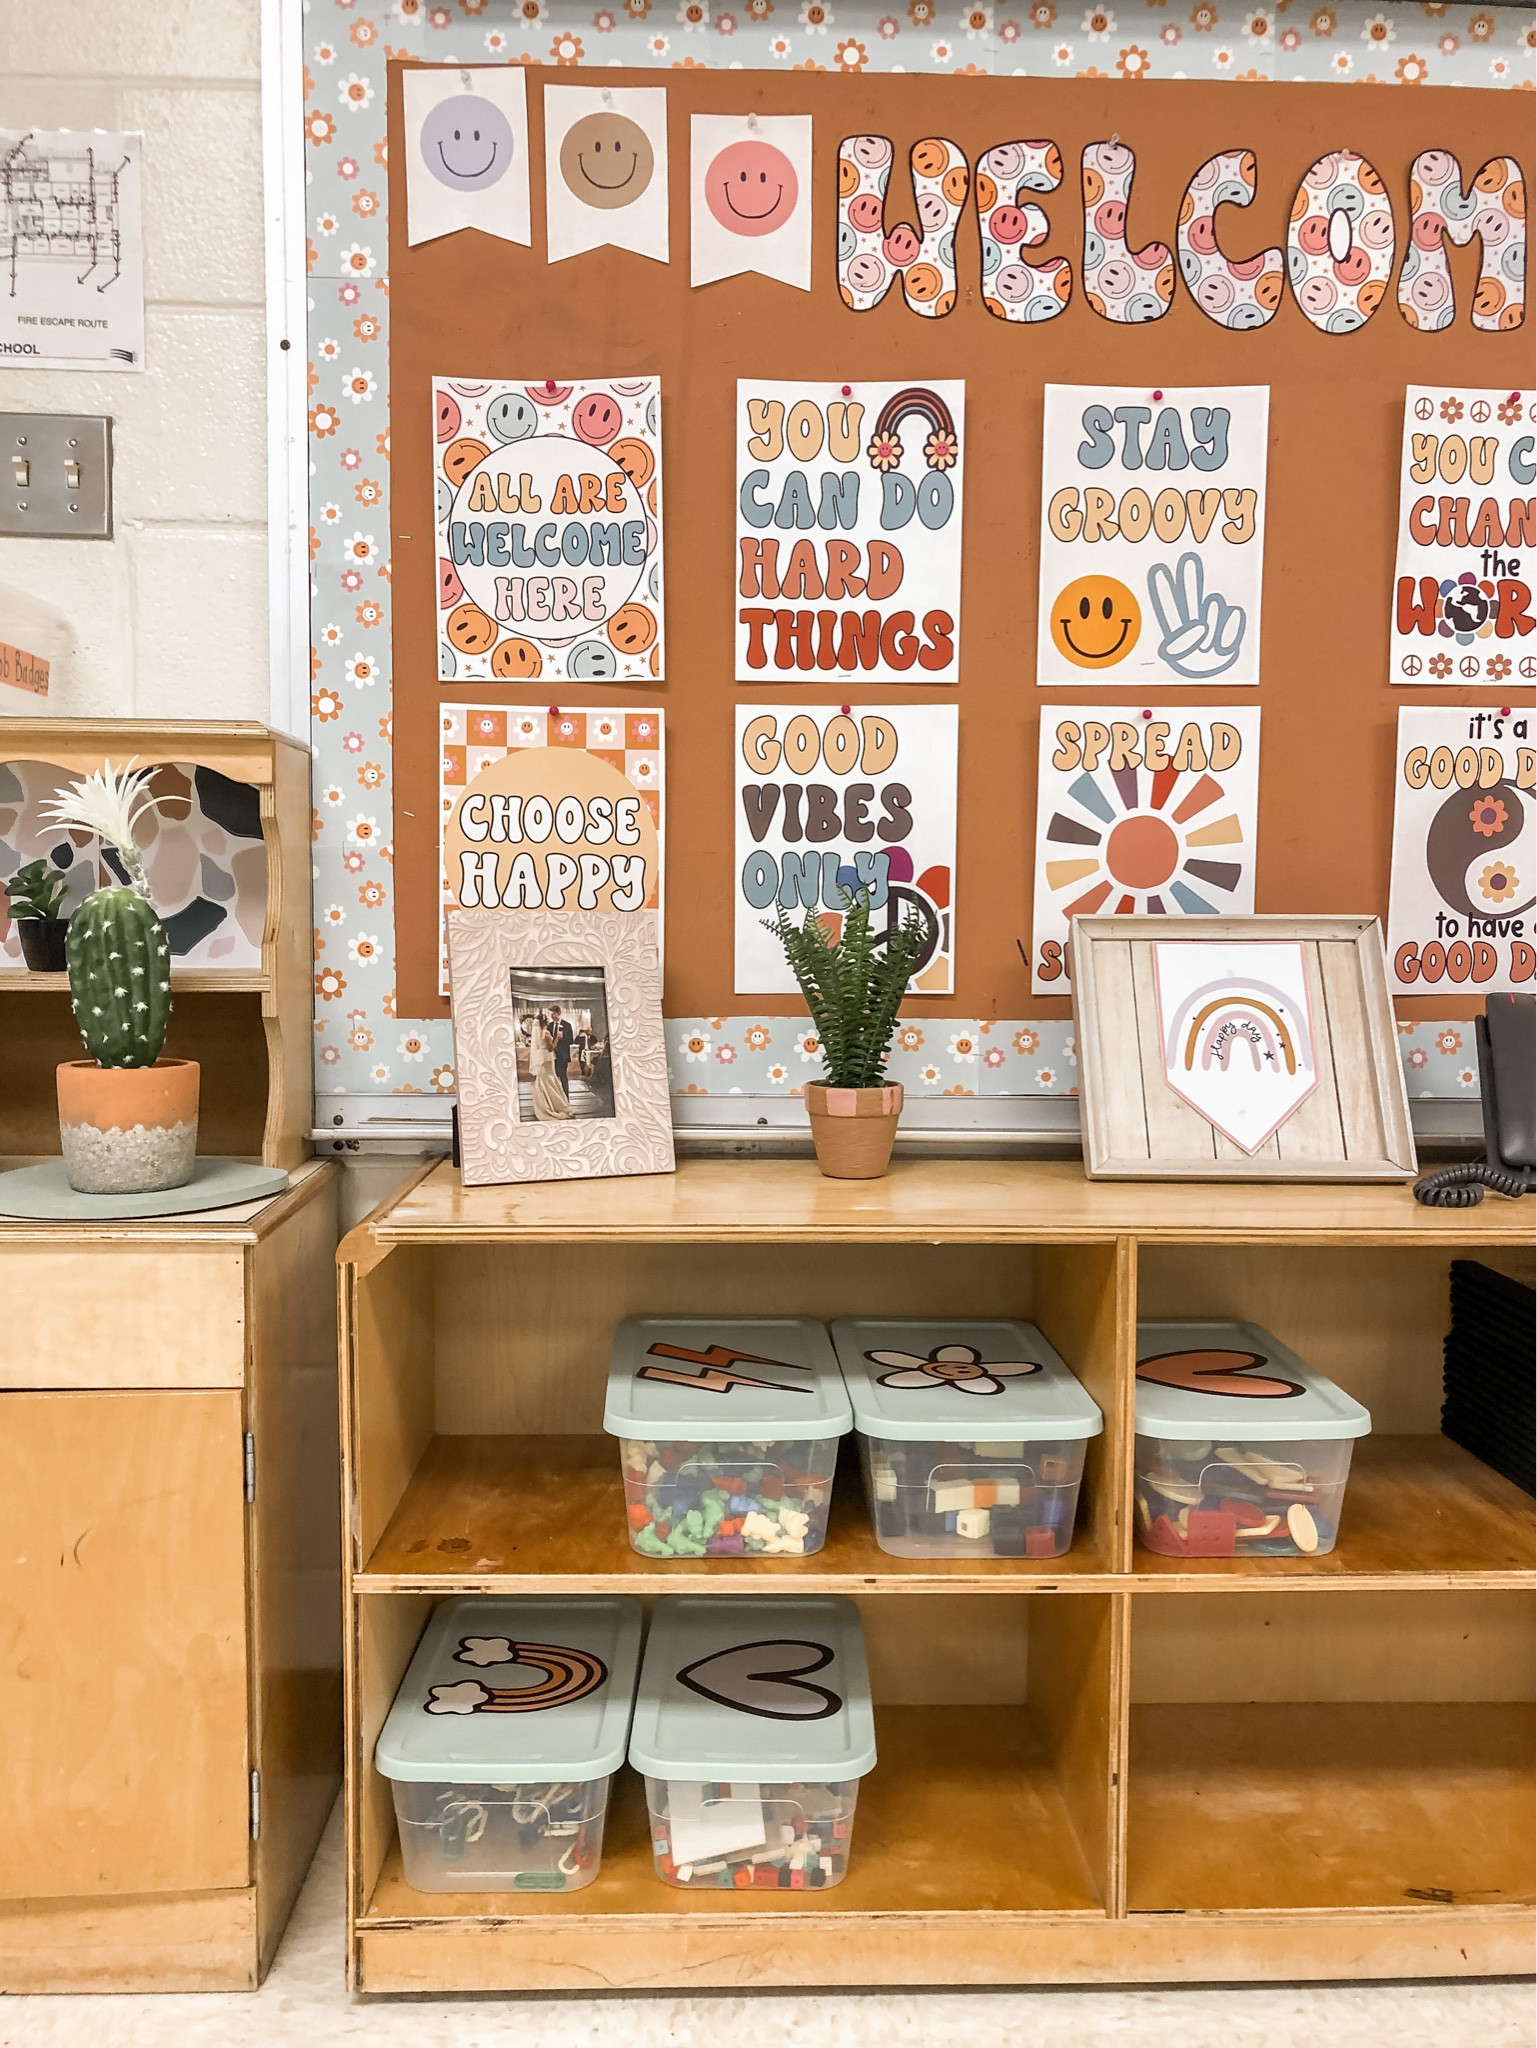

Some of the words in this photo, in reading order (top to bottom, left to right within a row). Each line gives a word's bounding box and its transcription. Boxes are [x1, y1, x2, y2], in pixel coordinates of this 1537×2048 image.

[17, 316, 38, 325] FIRE
[40, 317, 75, 327] ESCAPE
[78, 320, 108, 328] ROUTE
[747, 399, 865, 463] YOU
[1078, 405, 1231, 471] STAY
[1410, 433, 1499, 485] YOU
[469, 472, 542, 514] ALL
[550, 472, 627, 514] ARE
[740, 469, 860, 530] CAN
[880, 470, 954, 530] DO
[1048, 487, 1257, 544] GROOVY
[452, 521, 647, 567] WELCOME
[1409, 495, 1536, 548] CHAN
[740, 537, 904, 600] HARD
[1480, 549, 1521, 577] the
[494, 576, 606, 621] HERE
[739, 608, 954, 670] THINGS
[15, 650, 49, 692] Badges
[742, 715, 898, 775] GOOD
[1052, 721, 1242, 772] SPREAD
[1469, 713, 1504, 740] it's
[1512, 719, 1528, 739] a
[1404, 746, 1503, 789] GOOD
[460, 794, 640, 845] CHOOSE
[742, 783, 913, 842] VIBES
[459, 851, 646, 912] HAPPY
[742, 850, 891, 910] ONLY
[1435, 911, 1460, 938] to
[1467, 912, 1524, 938] have
[1394, 941, 1497, 983] GOOD
